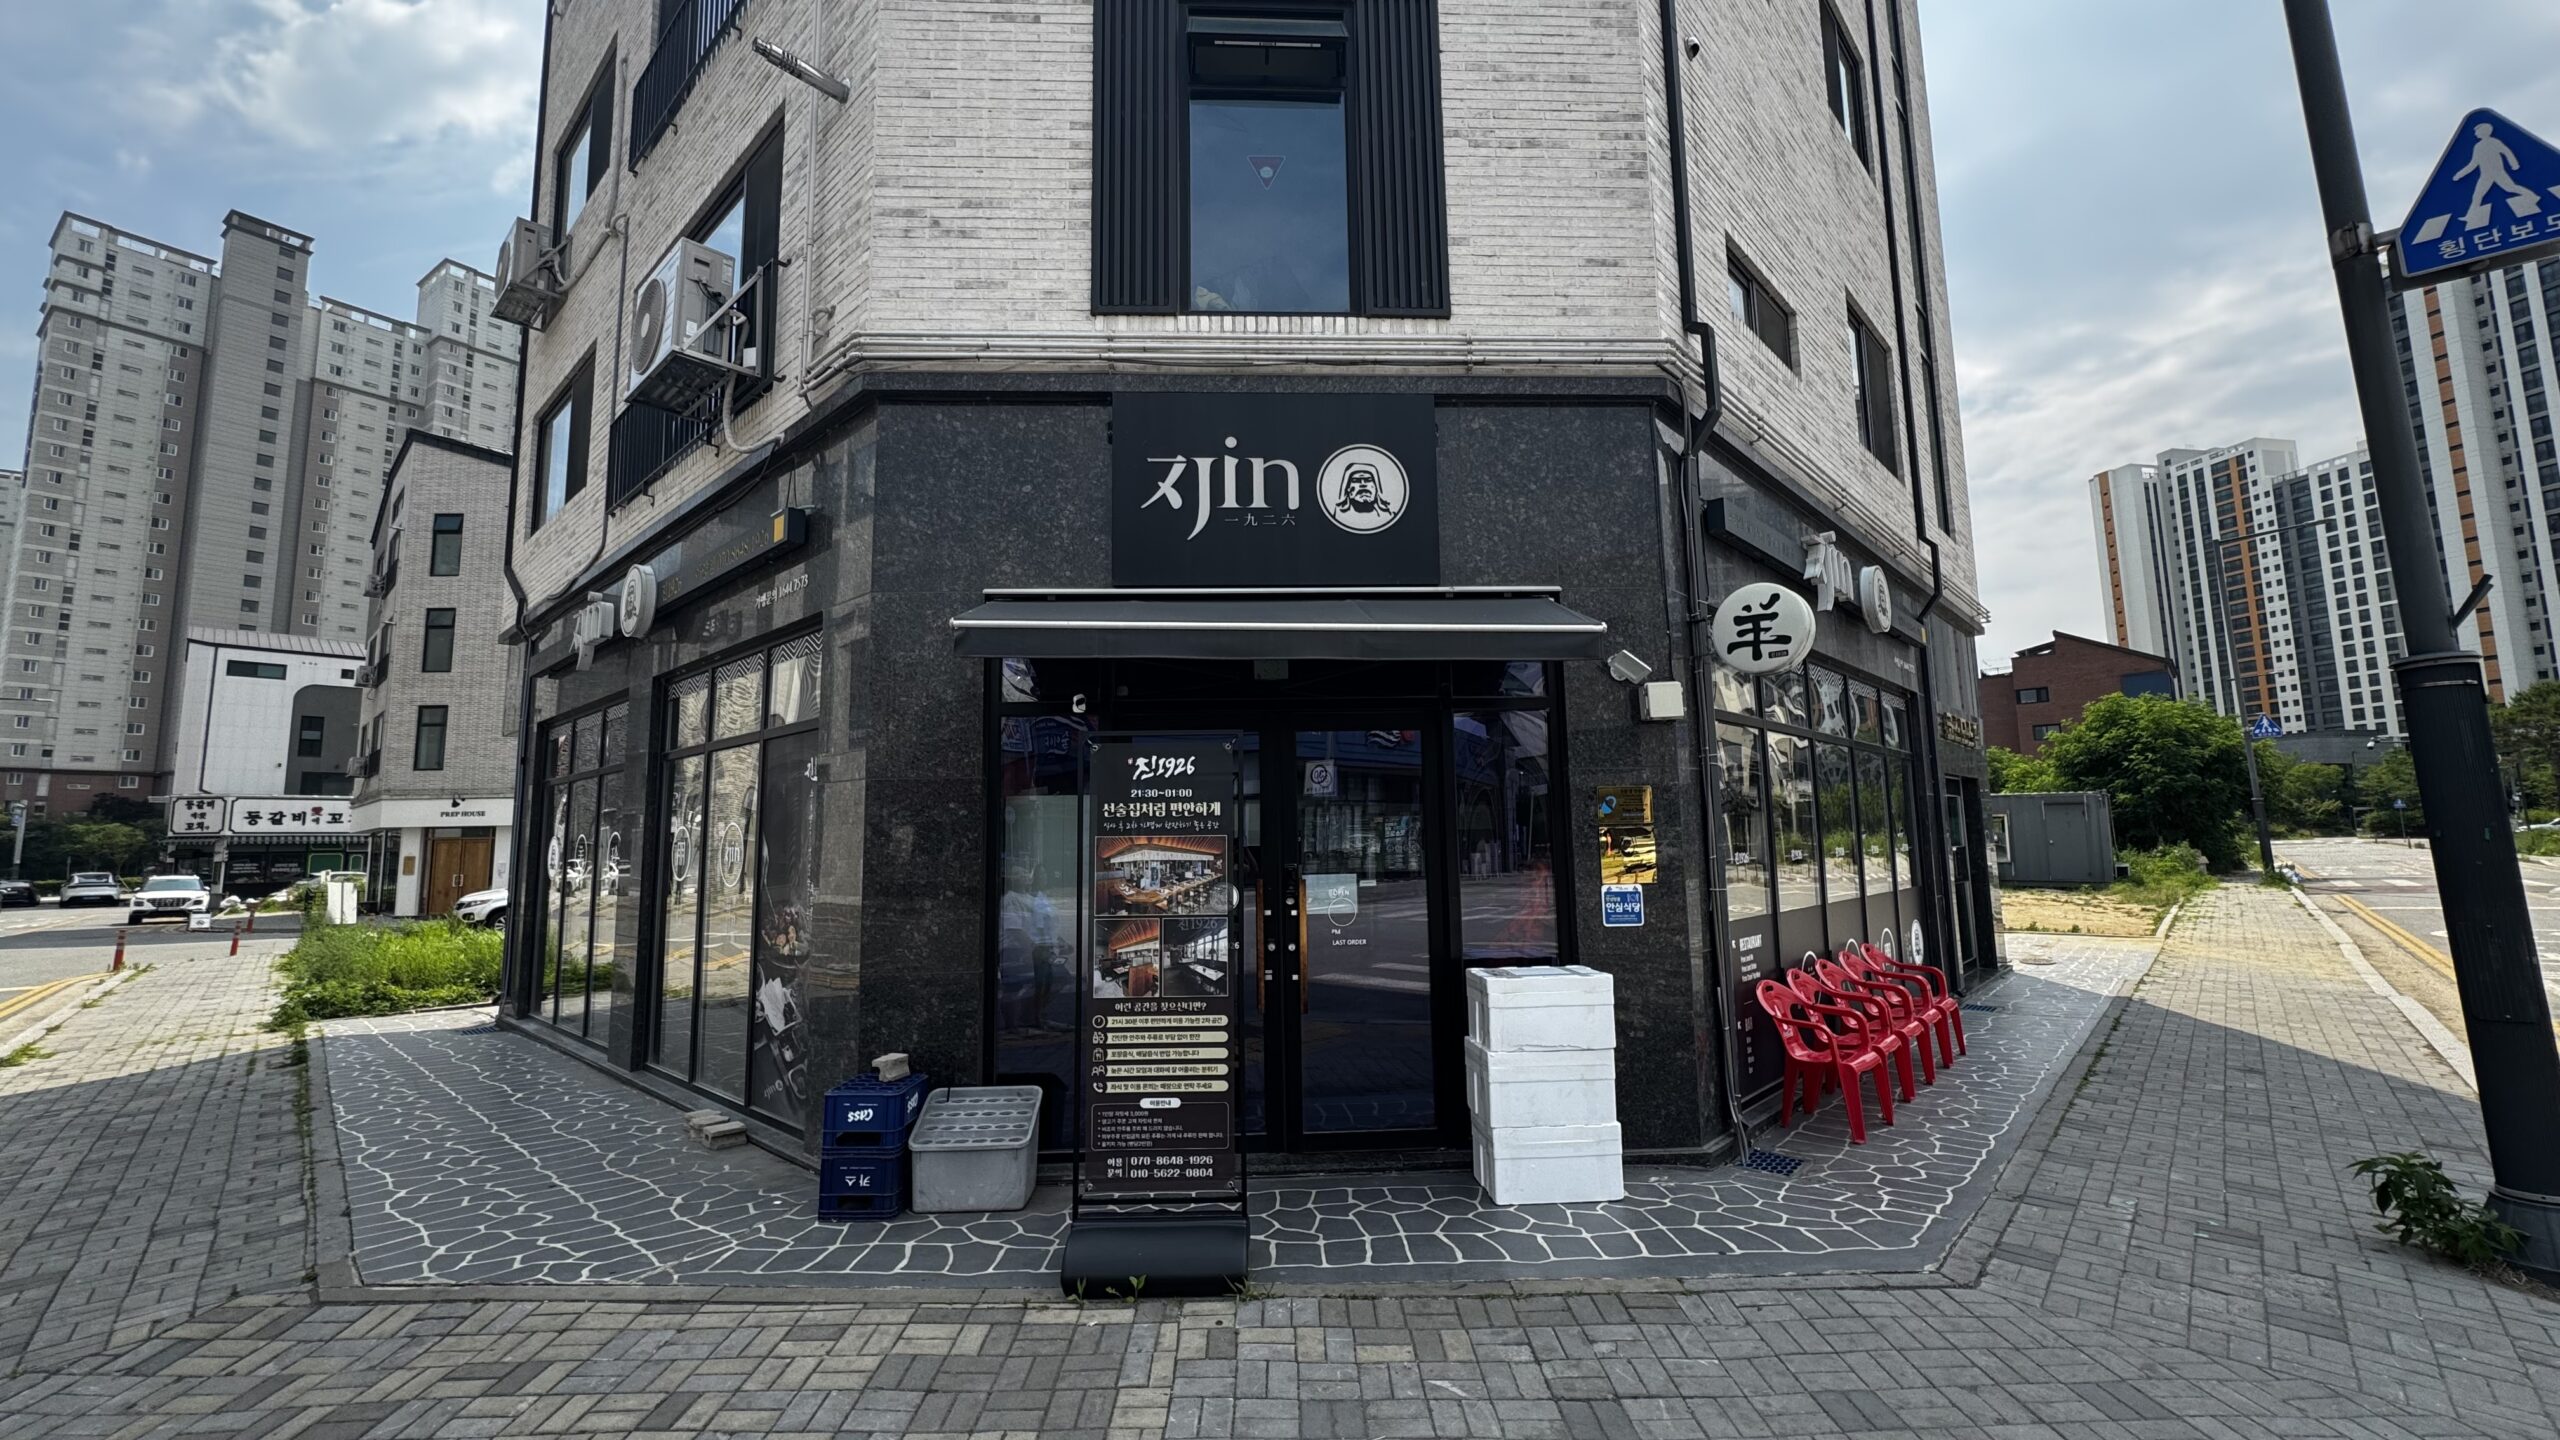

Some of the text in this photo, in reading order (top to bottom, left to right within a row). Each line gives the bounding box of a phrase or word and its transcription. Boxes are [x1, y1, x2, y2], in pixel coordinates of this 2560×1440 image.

[1224, 513, 1296, 527] 一九二六
[1727, 593, 1792, 661] 羊
[1130, 788, 1193, 798] 21:30~01:00
[1102, 801, 1221, 818] 선술집처럼 편안하게
[243, 810, 307, 826] 등갈비
[1605, 902, 1641, 913] 안심식당
[1130, 1155, 1214, 1166] 070-8648-1926
[1130, 1168, 1214, 1178] 010-5622-0804
